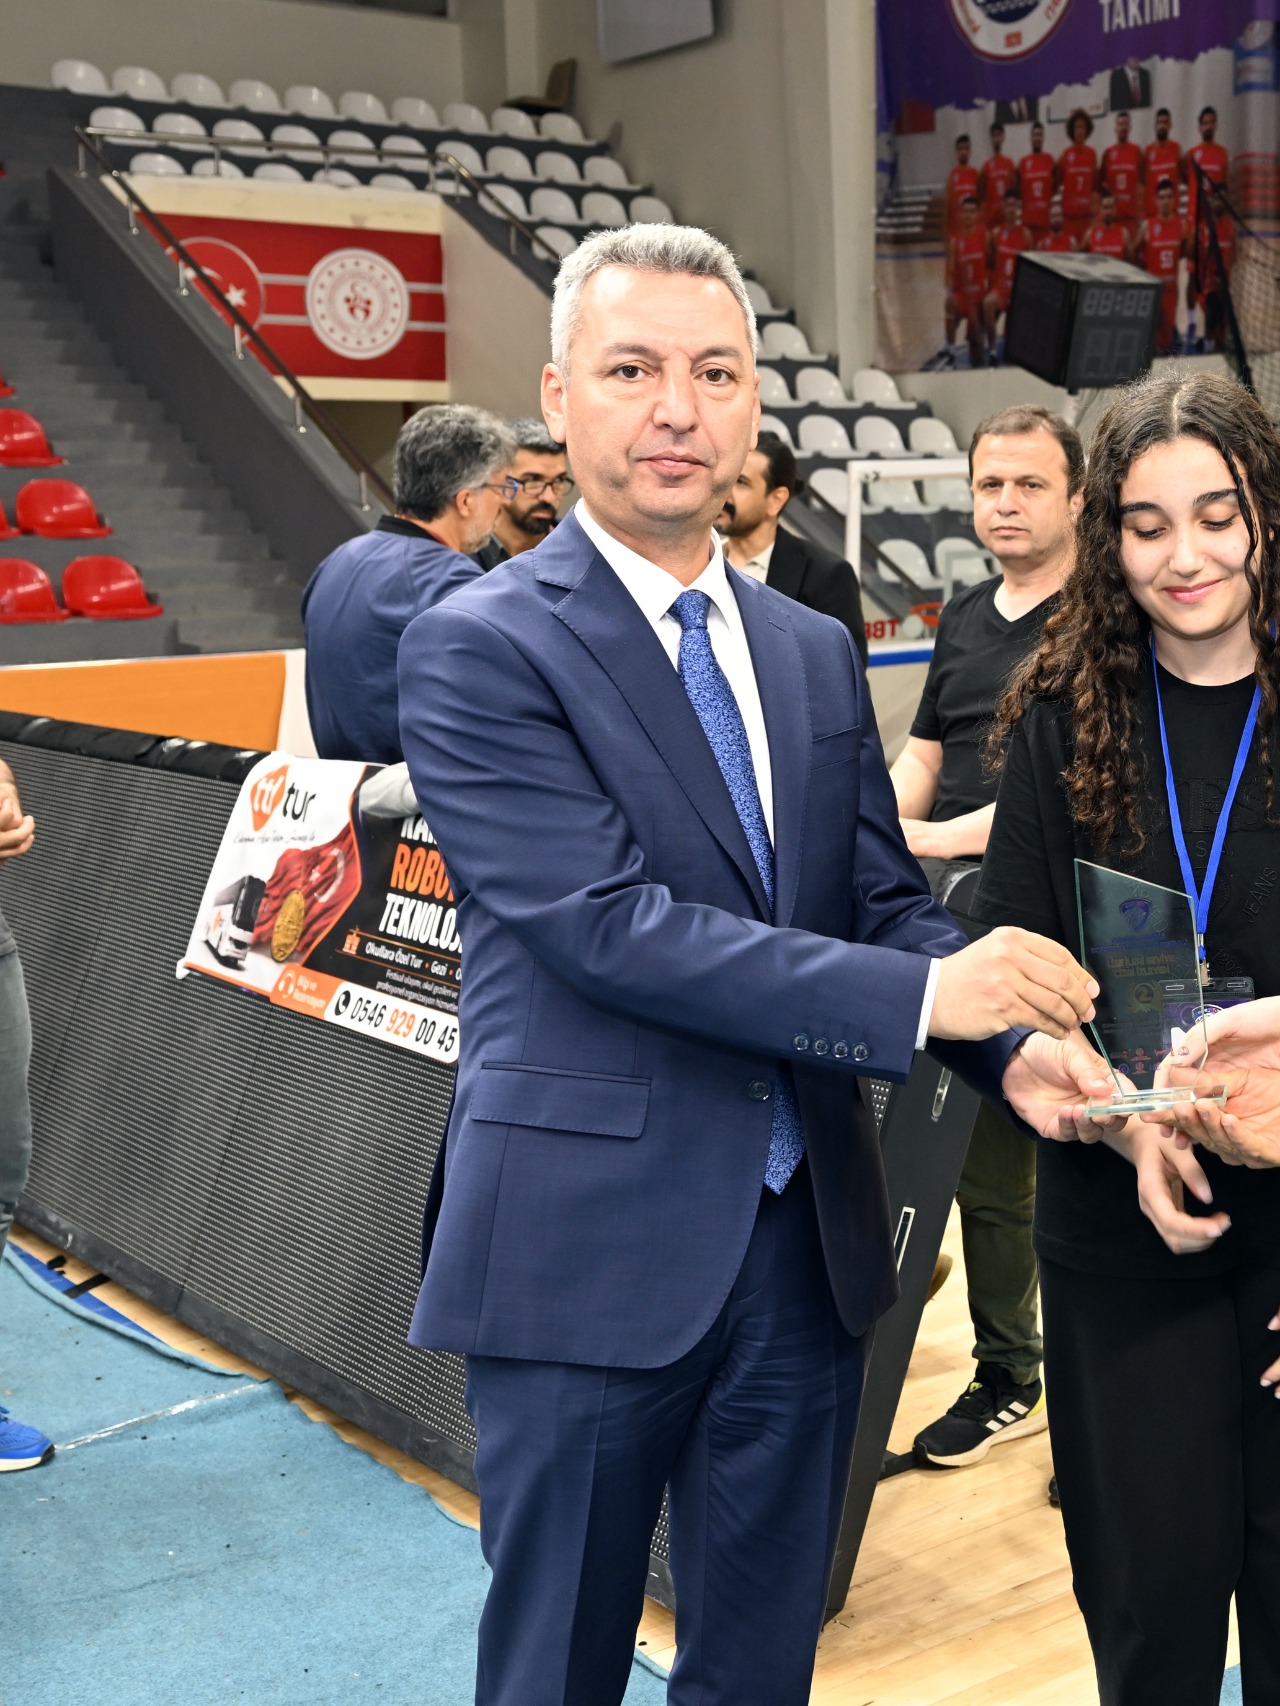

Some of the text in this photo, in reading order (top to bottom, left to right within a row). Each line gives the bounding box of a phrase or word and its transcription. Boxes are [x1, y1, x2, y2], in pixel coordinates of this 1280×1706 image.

[282, 782, 316, 822] tur
[390, 843, 454, 902] ROBO
[379, 893, 462, 953] TEKNOLOJ
[365, 941, 395, 961] Okullara
[410, 954, 423, 969] Tur
[350, 997, 458, 1053] 0546 929 00 45
